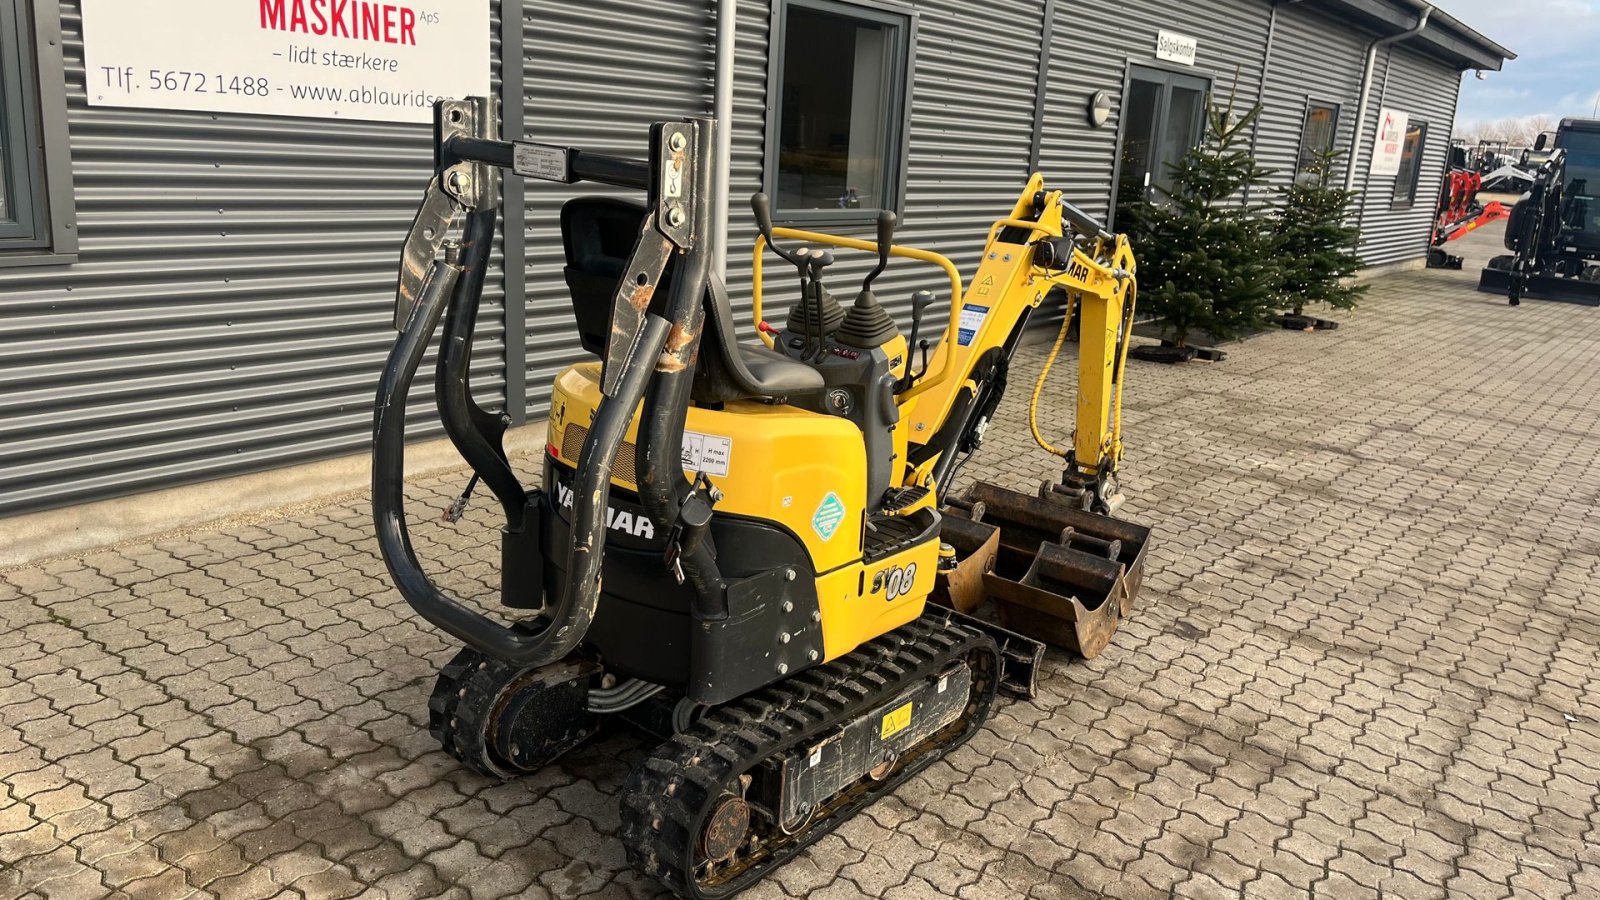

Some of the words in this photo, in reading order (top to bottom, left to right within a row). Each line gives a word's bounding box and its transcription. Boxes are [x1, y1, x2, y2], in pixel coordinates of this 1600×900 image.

[259, 0, 416, 46] MASKINER
[419, 11, 440, 25] ApS
[288, 45, 317, 65] lidt
[322, 50, 398, 73] stærkere
[1159, 36, 1195, 58] Salgskontor
[101, 66, 140, 93] Tlf.
[149, 69, 207, 93] 5672
[215, 74, 269, 97] 1488
[290, 84, 474, 108] www.ablaurids
[557, 481, 655, 540] YAAR
